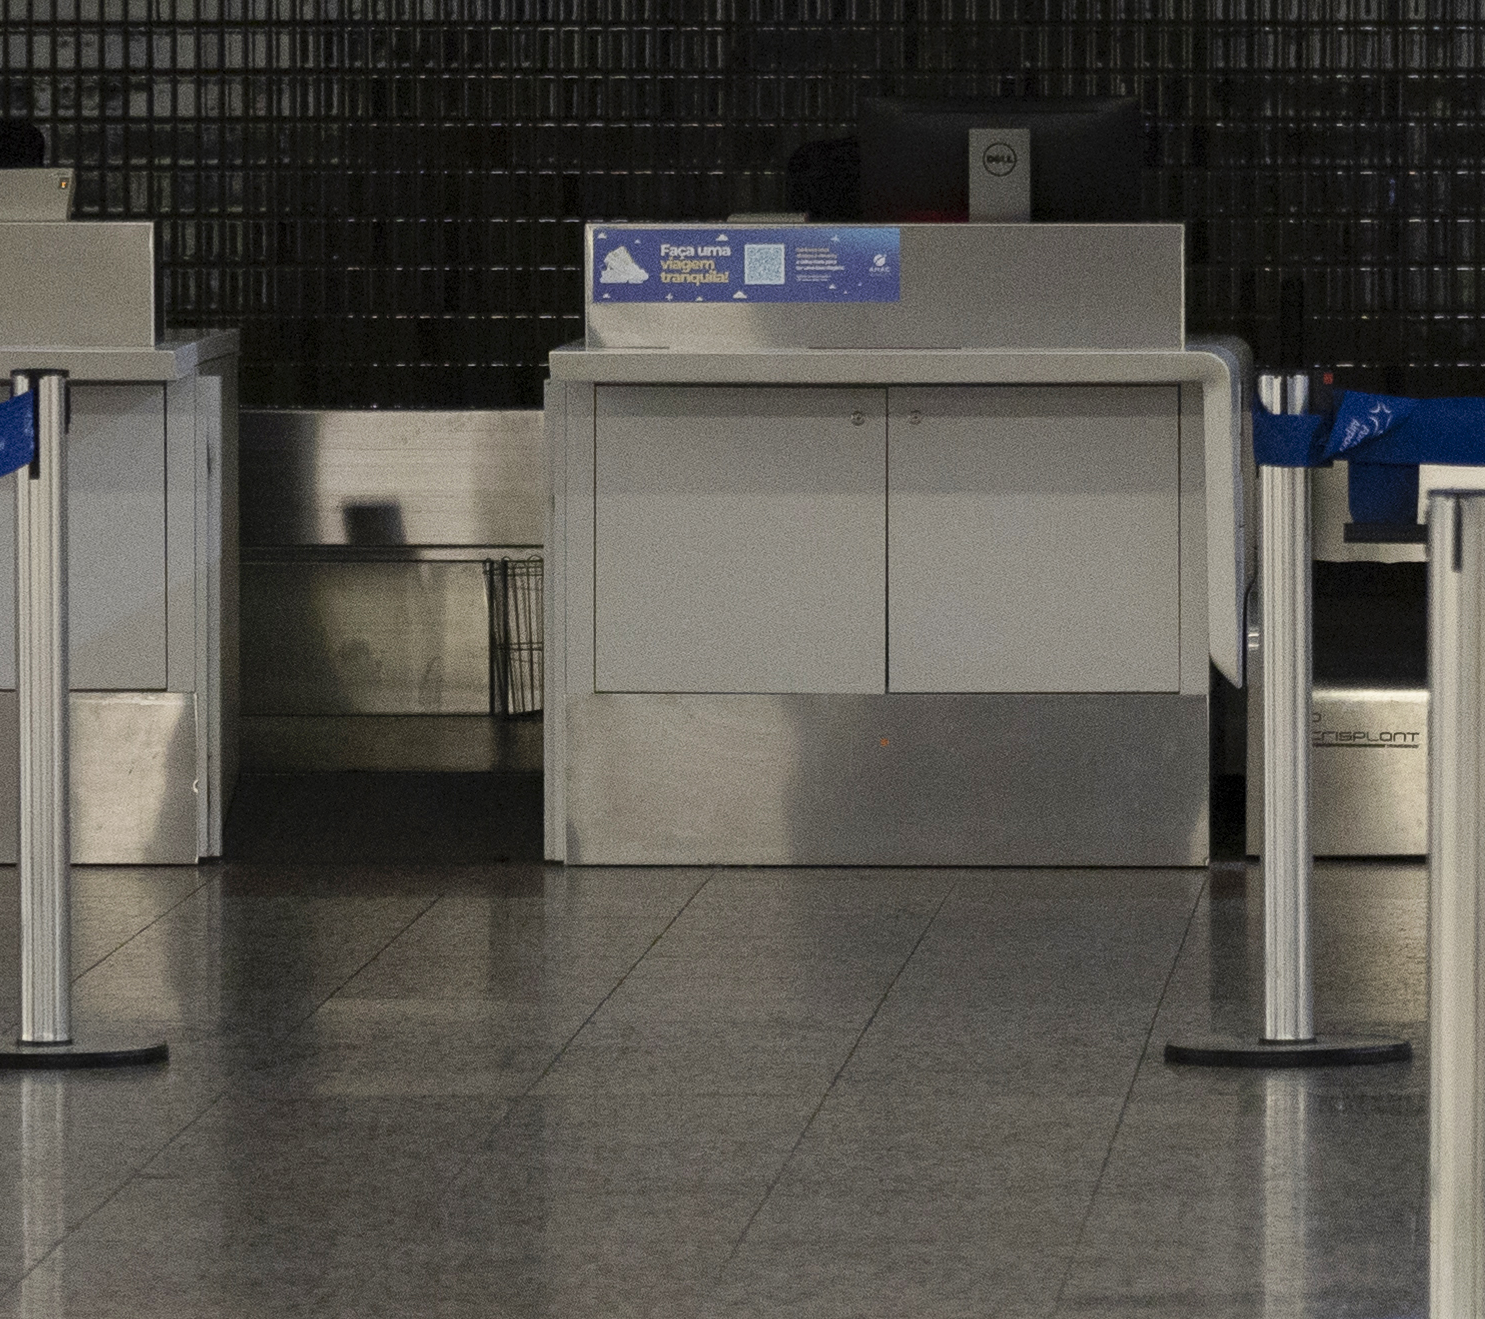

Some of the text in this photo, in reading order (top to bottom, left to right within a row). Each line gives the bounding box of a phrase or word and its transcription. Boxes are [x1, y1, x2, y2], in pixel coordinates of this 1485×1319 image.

[660, 244, 731, 259] Faça uma
[660, 258, 714, 272] viagem
[660, 271, 729, 285] tranquila!
